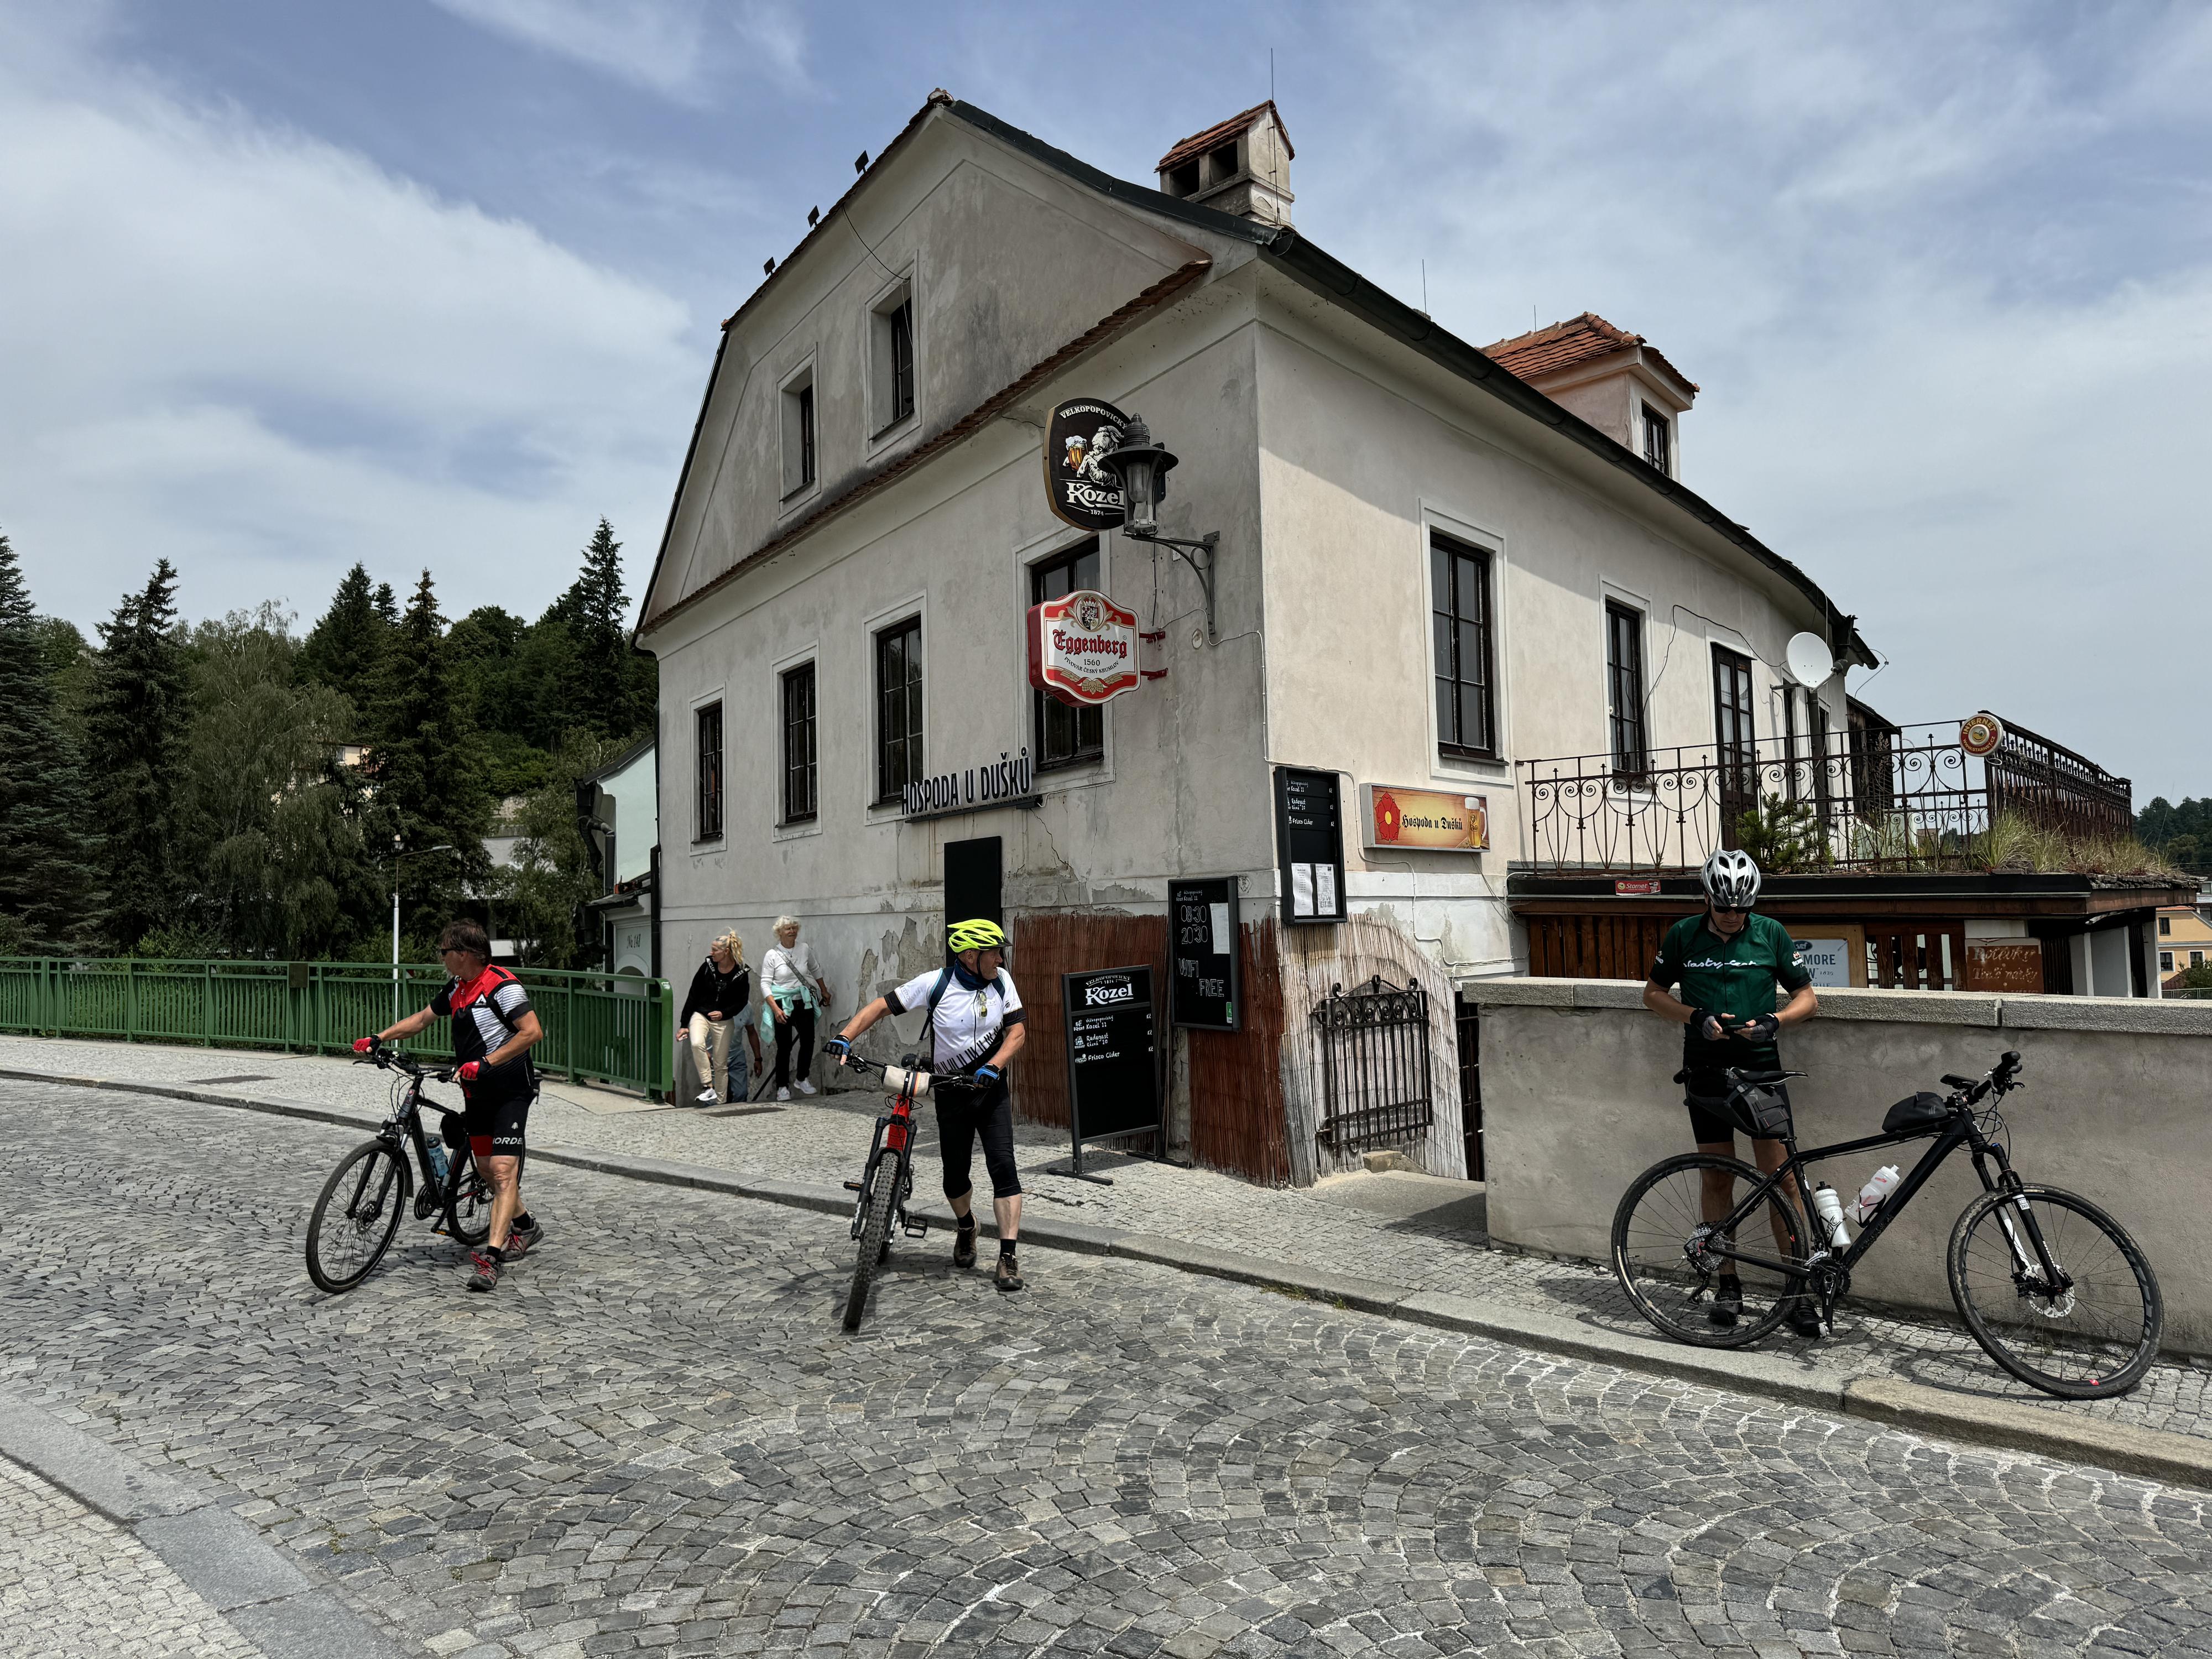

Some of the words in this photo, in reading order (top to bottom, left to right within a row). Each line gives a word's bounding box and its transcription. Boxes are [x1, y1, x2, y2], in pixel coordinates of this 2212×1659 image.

[1066, 482, 1124, 507] Kozel
[1052, 629, 1128, 659] Eggenberg
[1064, 656, 1082, 671] PIVOVAR
[1099, 661, 1119, 673] KRUMLOV
[1963, 718, 1996, 734] INTERNET
[902, 773, 959, 815] HOSPODA
[965, 769, 974, 804] U
[980, 747, 1030, 801] DUŠKŮ
[1402, 814, 1432, 831] Hospoda
[1434, 820, 1439, 829] u
[1441, 817, 1463, 831] Dušků
[1181, 905, 1207, 923] 08:30
[1181, 925, 1208, 945] 20:30
[1178, 958, 1198, 978] WIFI
[1803, 954, 1836, 965] MORE
[1085, 983, 1134, 1005] Kozel
[1199, 978, 1224, 997] FREE
